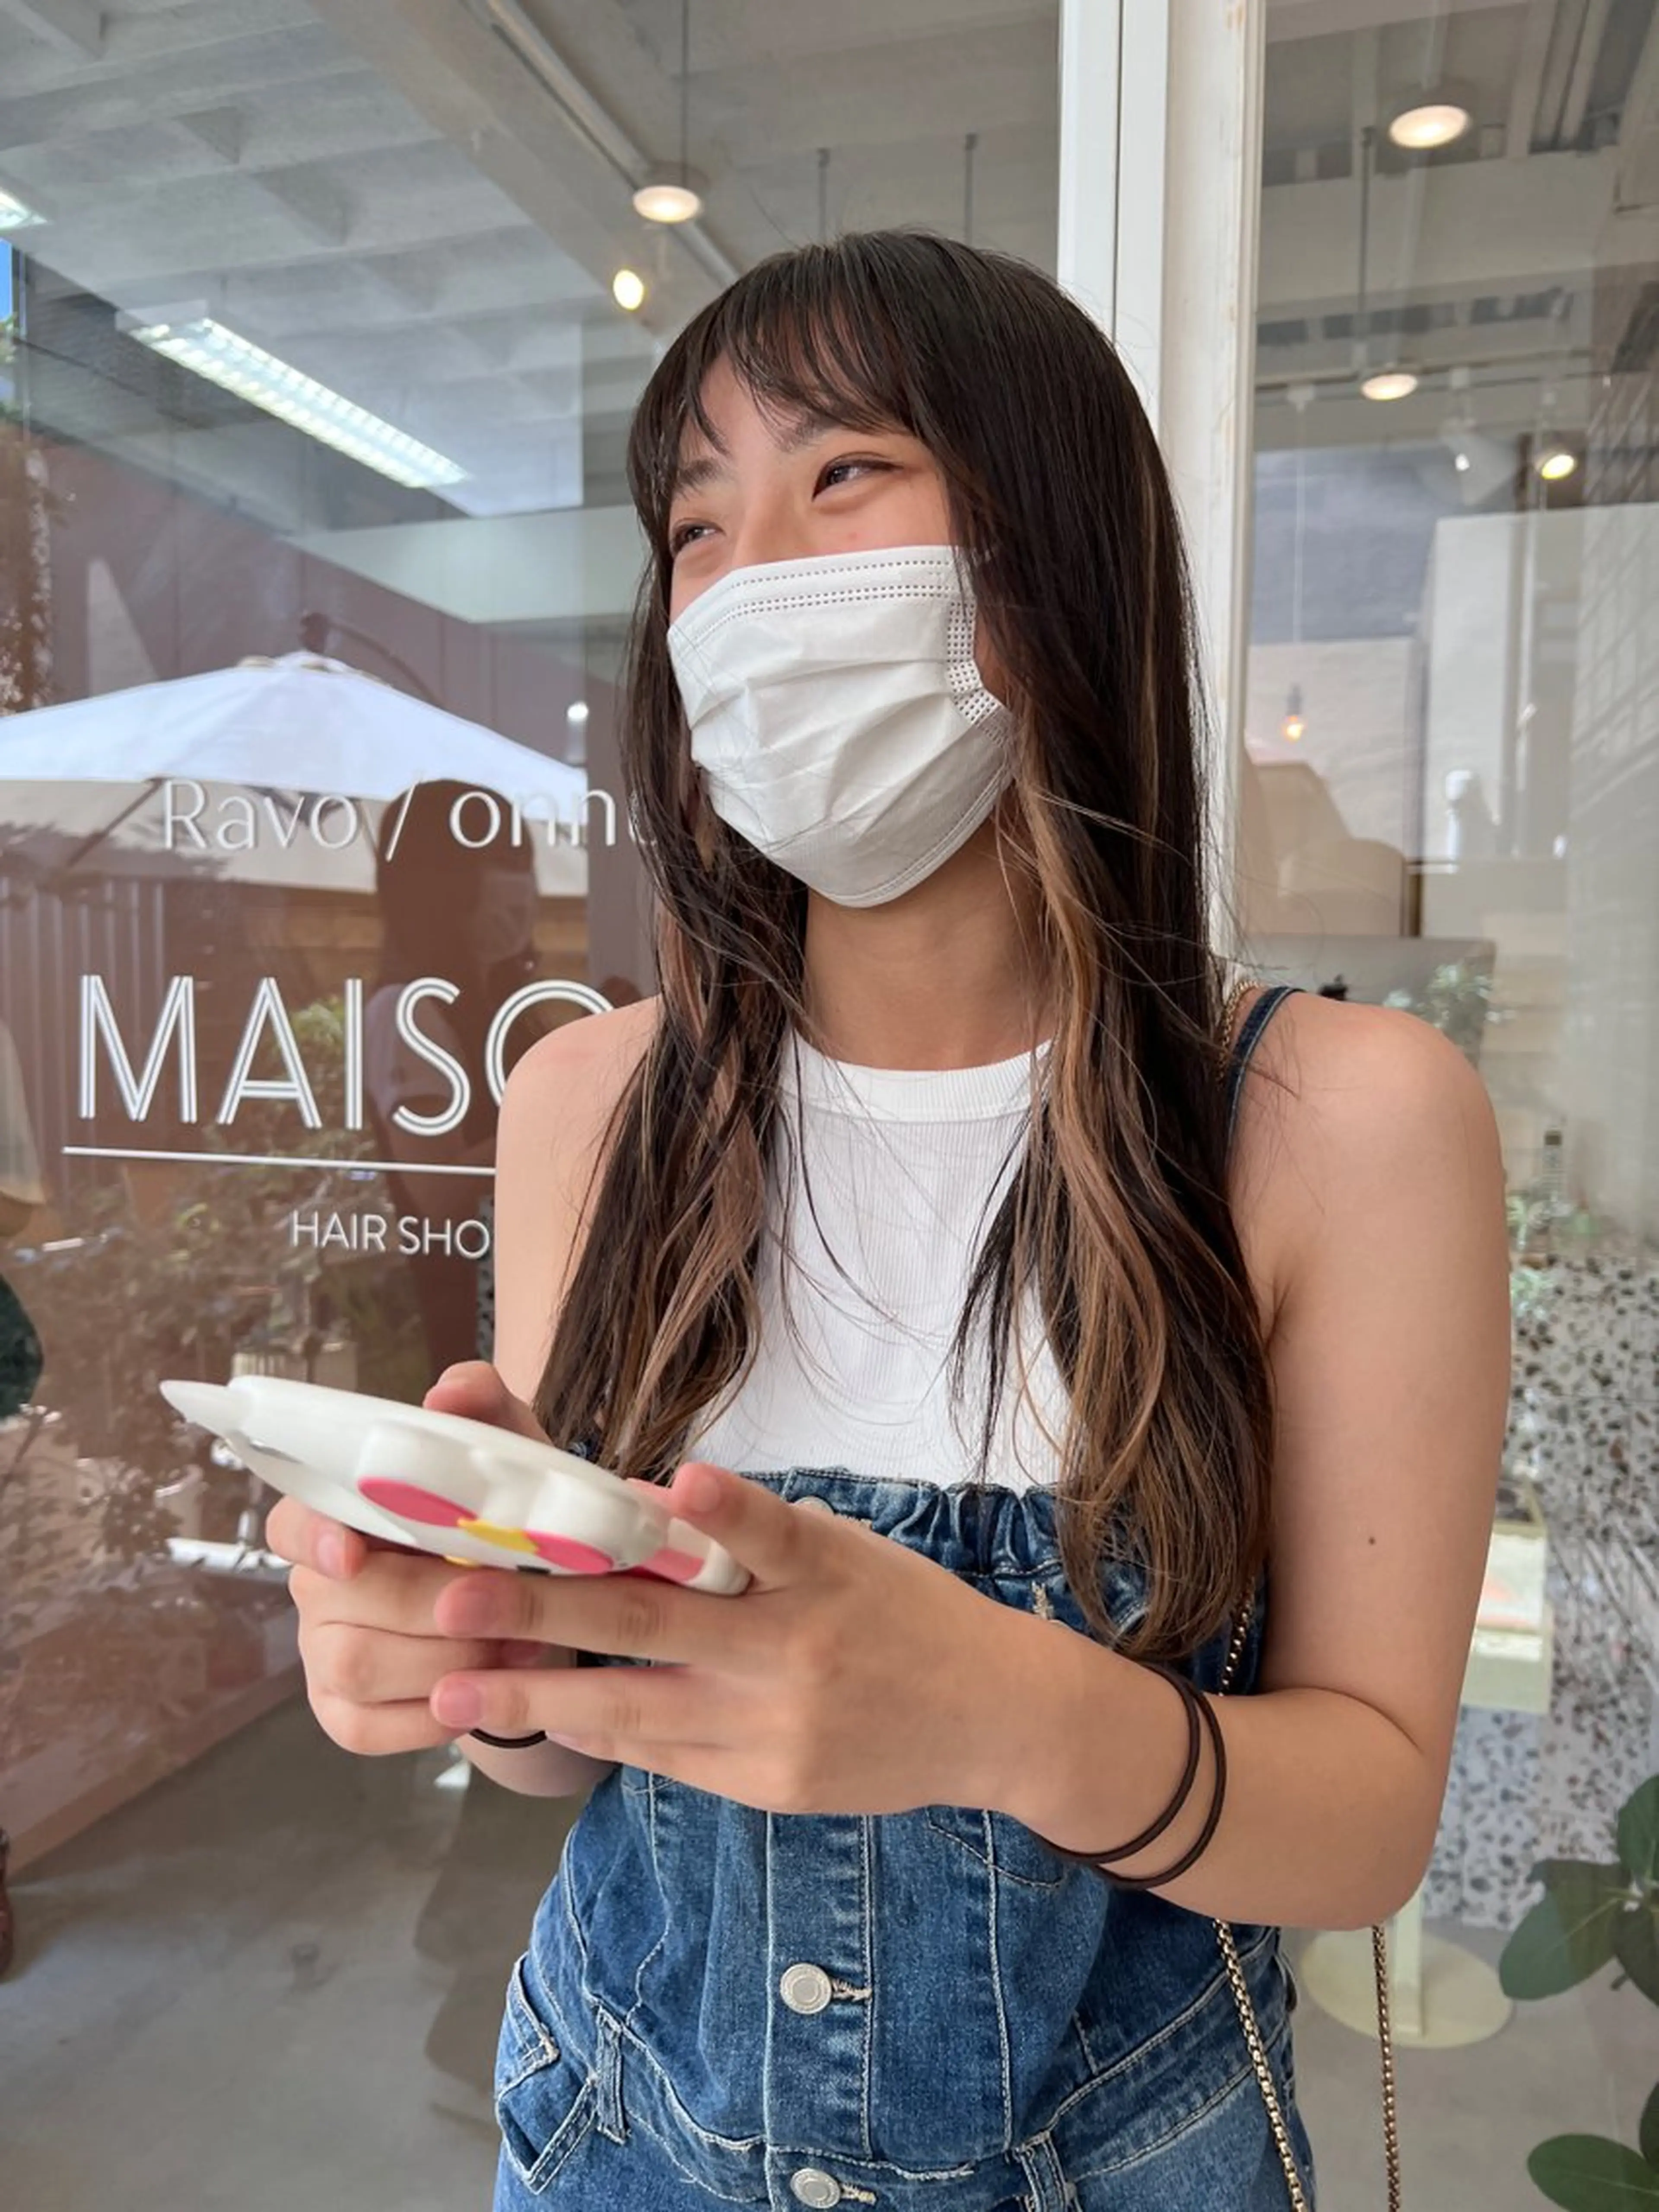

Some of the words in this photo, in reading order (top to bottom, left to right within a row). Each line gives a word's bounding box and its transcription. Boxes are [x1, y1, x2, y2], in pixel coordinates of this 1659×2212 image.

[165, 779, 357, 849] Ravo
[385, 771, 422, 862] /
[292, 1209, 387, 1252] HAIR
[398, 1215, 490, 1259] SHO
